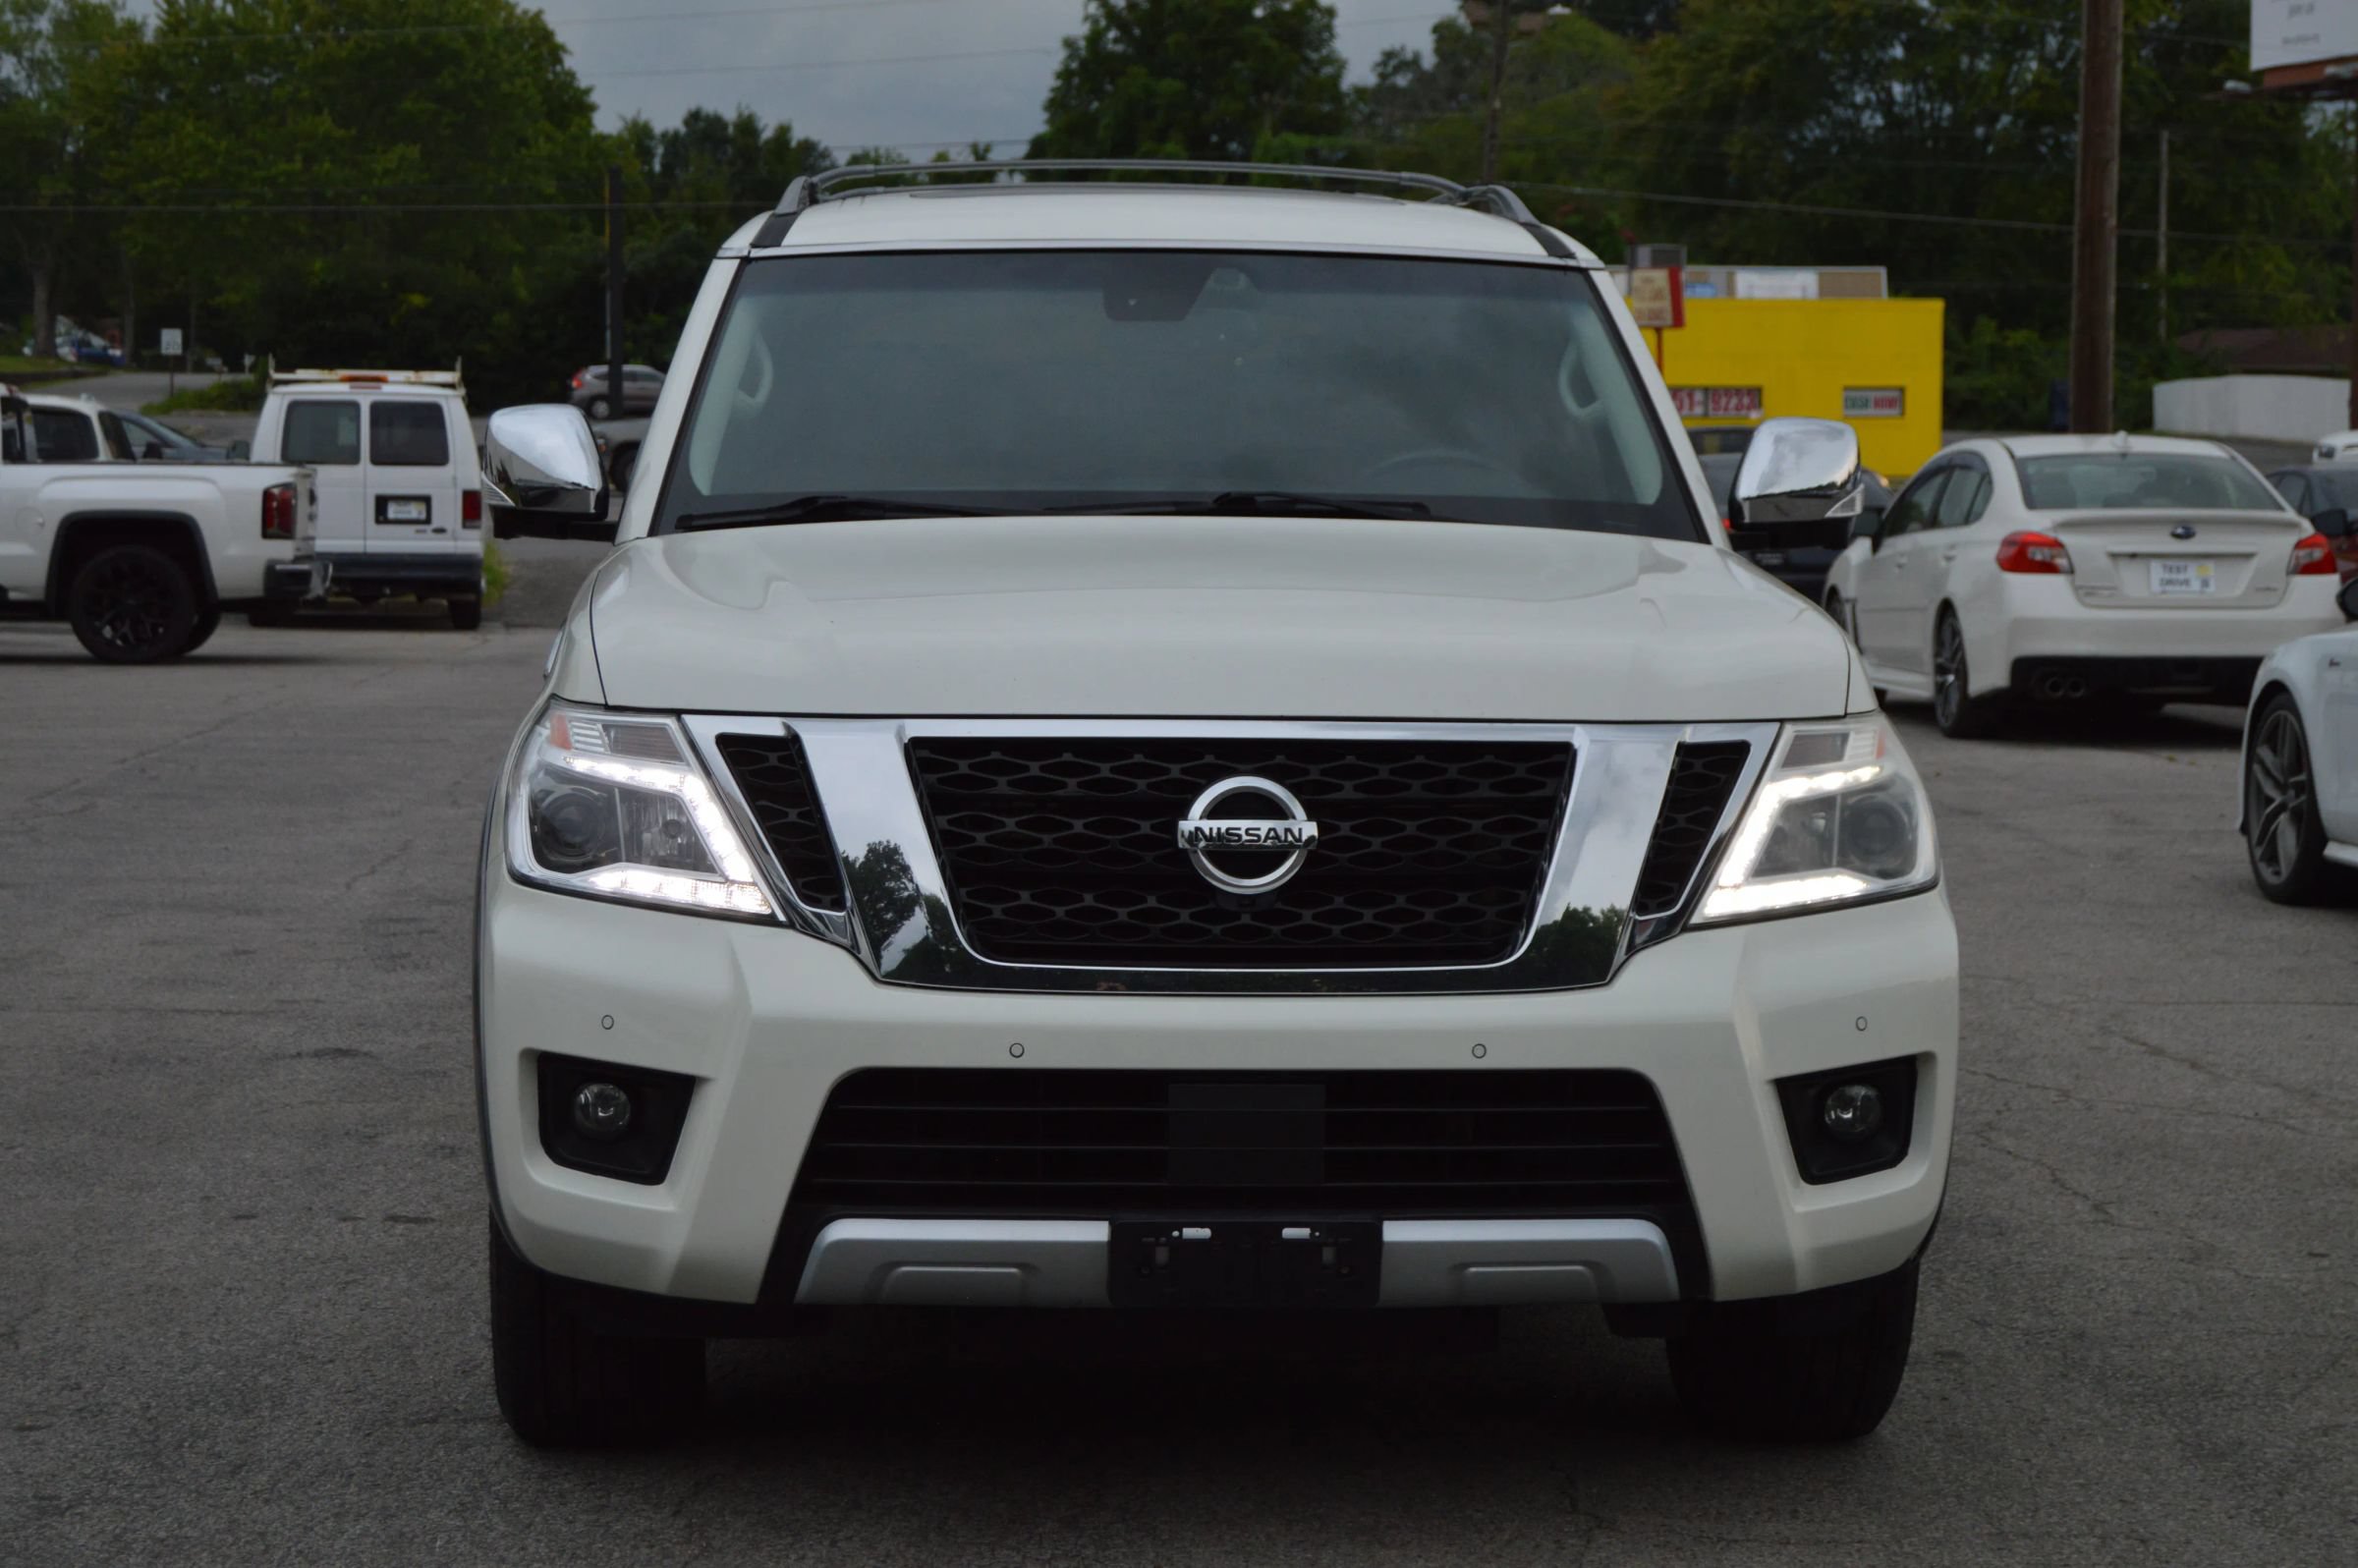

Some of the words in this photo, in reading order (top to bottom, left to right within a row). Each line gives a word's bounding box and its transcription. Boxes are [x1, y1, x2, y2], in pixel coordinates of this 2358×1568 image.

[2162, 563, 2188, 574] TEST
[2159, 577, 2190, 587] DRIVE
[1193, 826, 1303, 844] NISSAN
